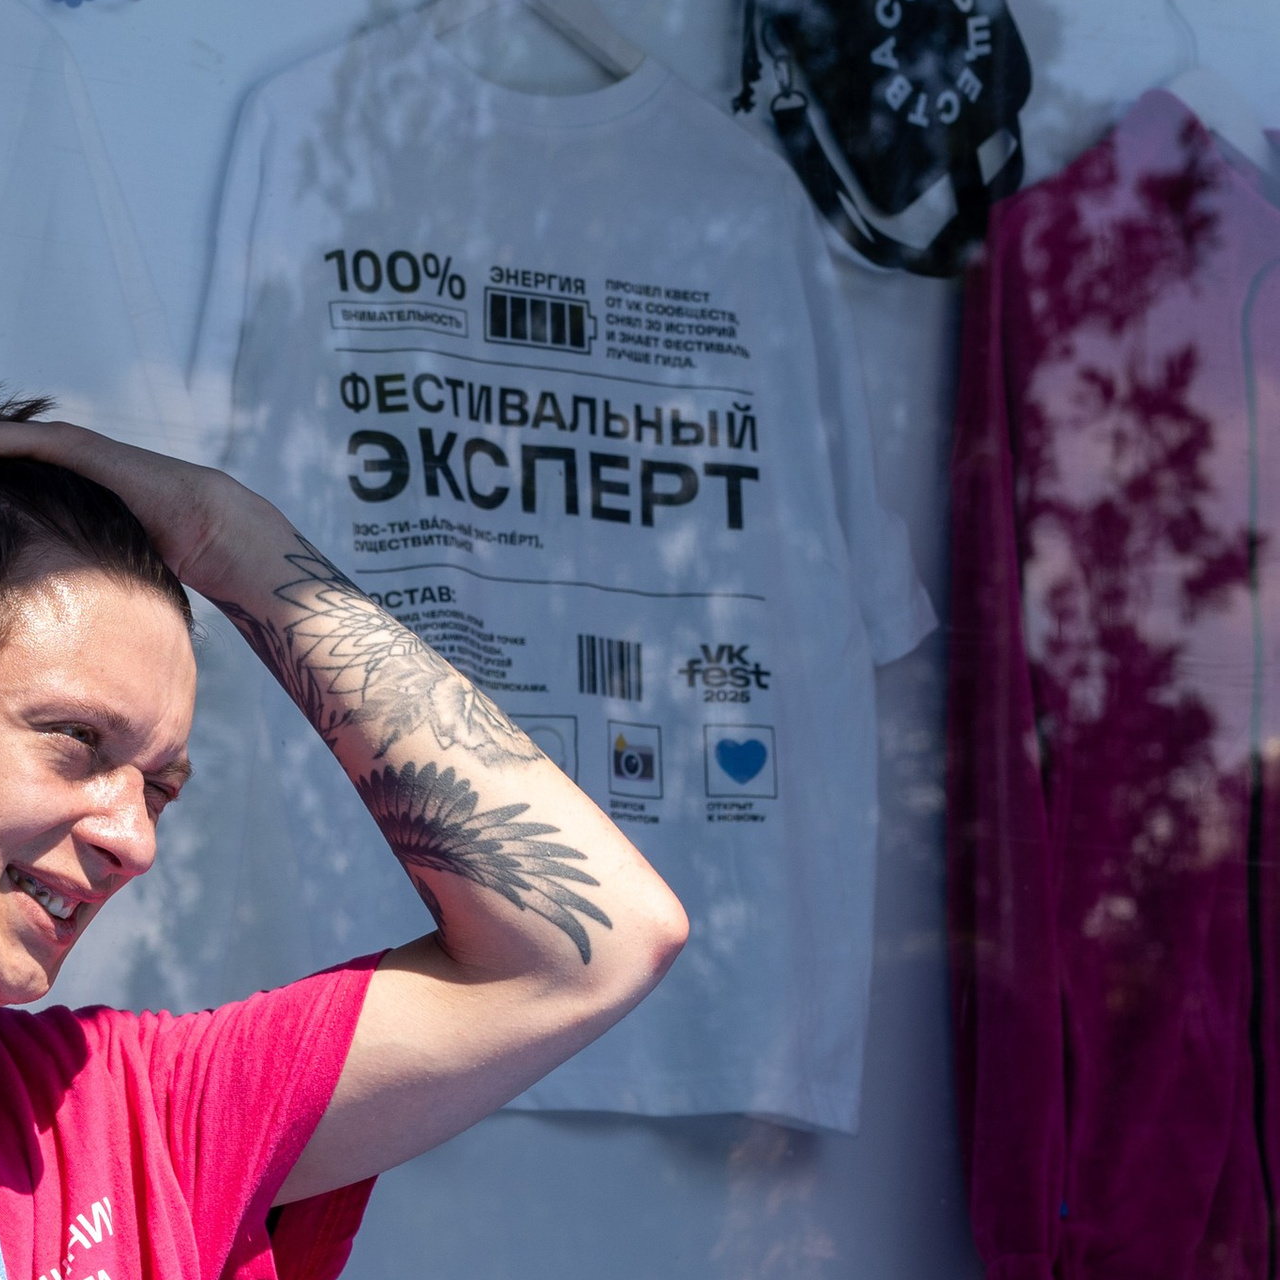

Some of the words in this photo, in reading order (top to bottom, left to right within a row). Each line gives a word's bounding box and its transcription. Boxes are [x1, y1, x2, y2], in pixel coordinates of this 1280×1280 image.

[324, 249, 466, 301] 100%
[490, 266, 587, 295] ЭНЕРГИЯ
[605, 296, 622, 308] ОТ
[665, 287, 710, 304] КВЕСТ
[341, 310, 462, 329] ВНИМАТЕЛЬНОСТЬ
[340, 371, 759, 453] ФЕСТИВАЛЬНЫЙ
[347, 426, 760, 531] ЭКСПЕРТ
[700, 644, 749, 666] VK
[678, 659, 772, 690] fest
[704, 690, 751, 703] 2025
